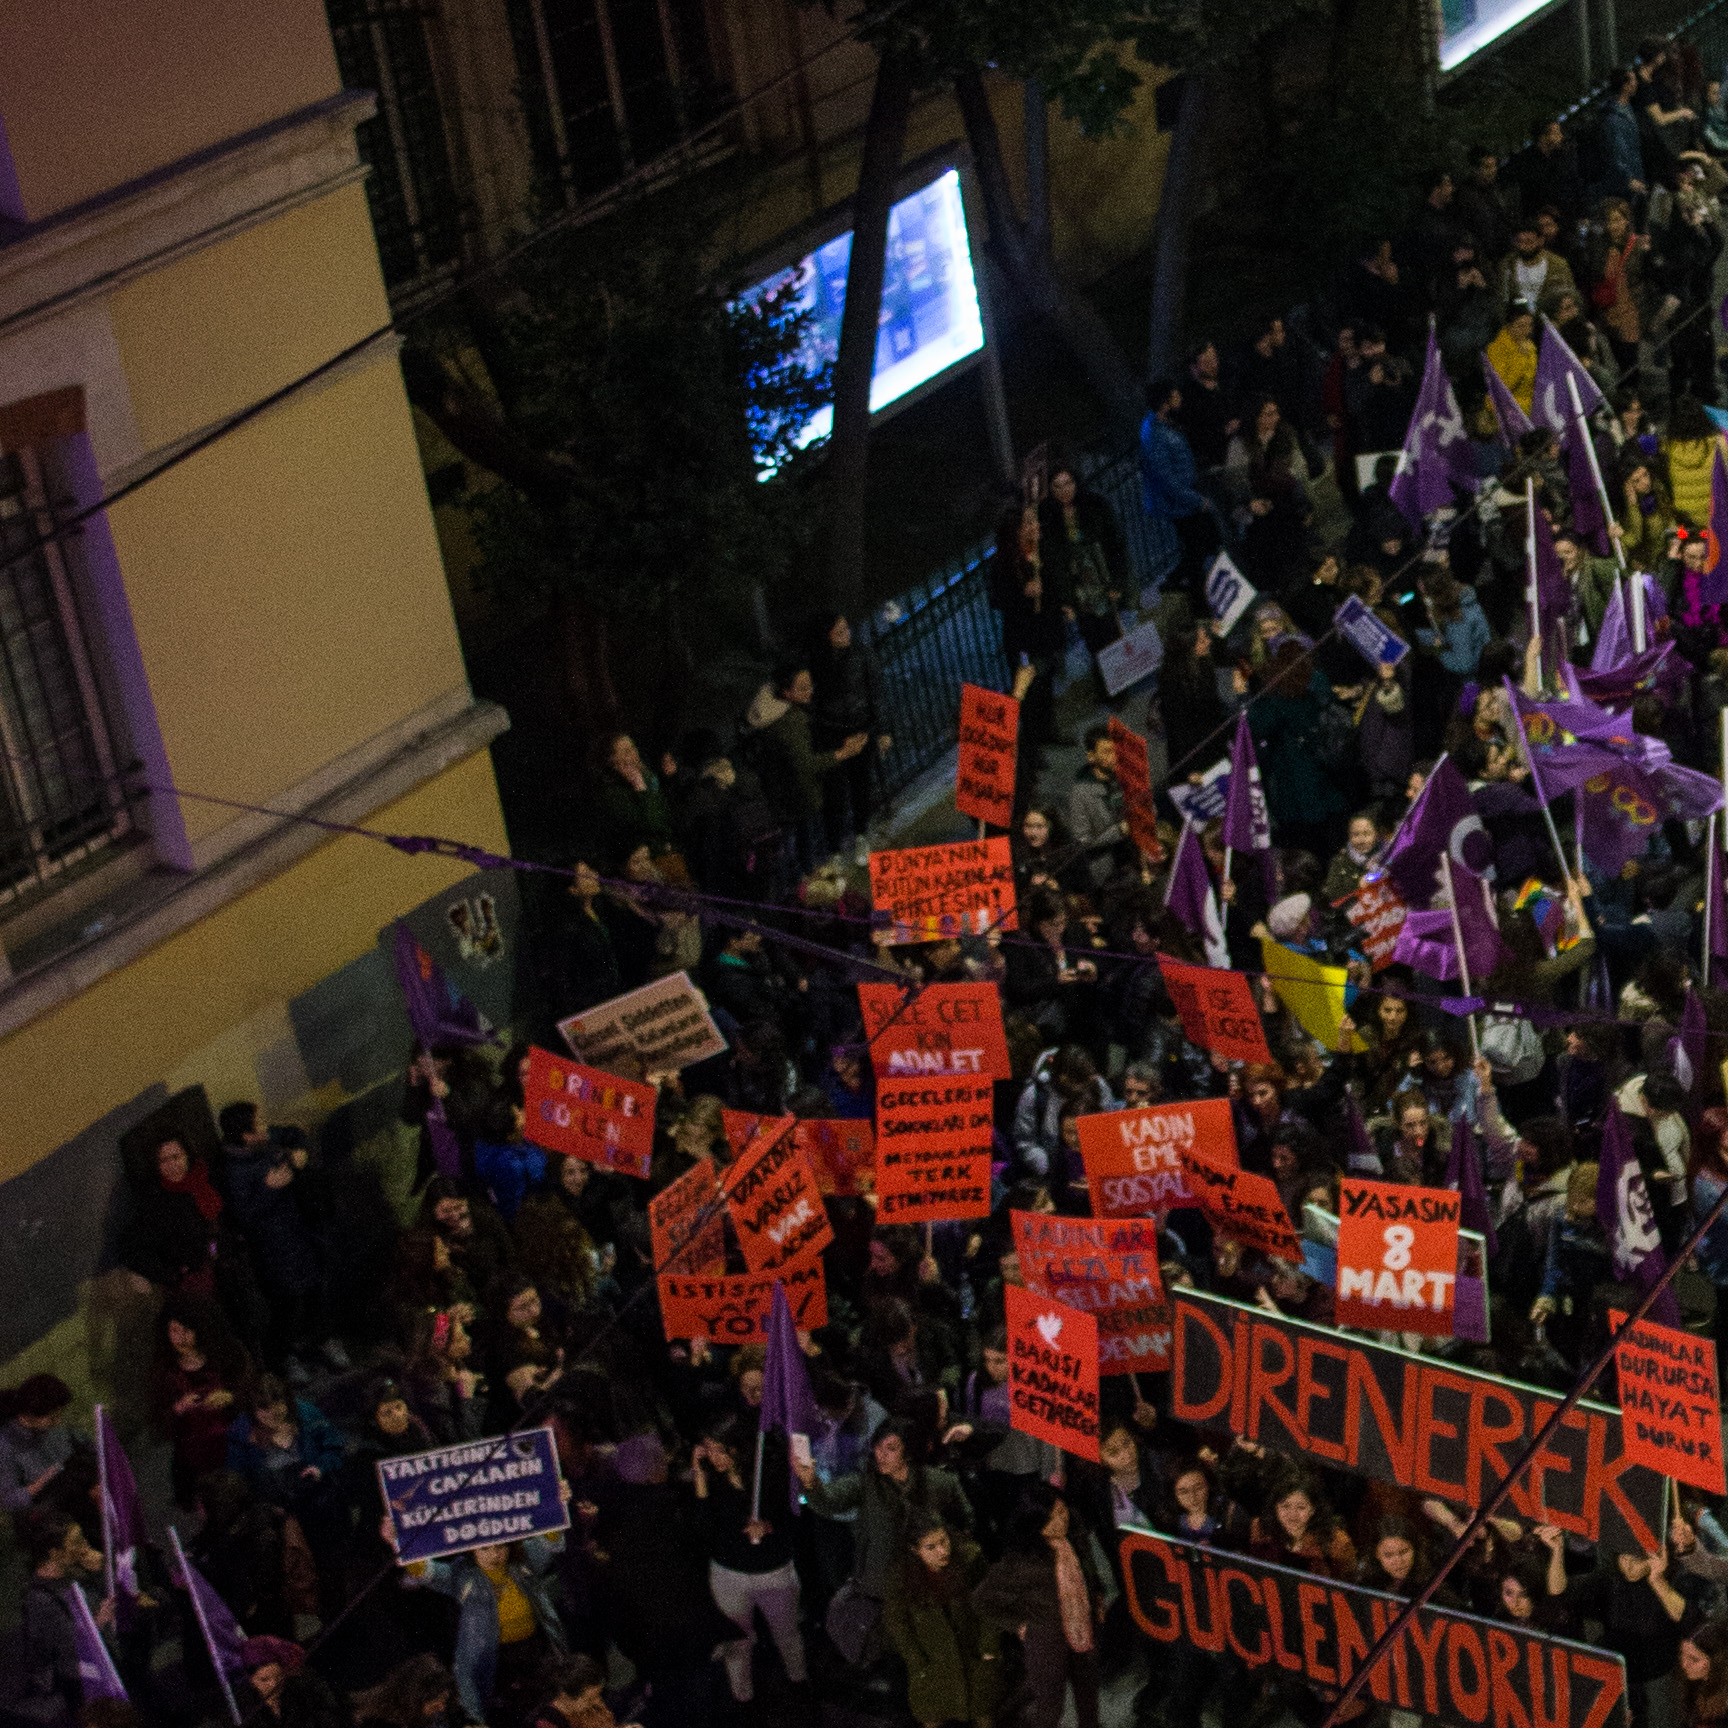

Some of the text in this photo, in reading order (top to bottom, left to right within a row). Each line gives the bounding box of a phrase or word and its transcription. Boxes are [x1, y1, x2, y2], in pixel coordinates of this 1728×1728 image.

[888, 1047, 986, 1074] ADALET
[1119, 1112, 1196, 1148] KADIN
[1382, 1223, 1416, 1272] 8
[1339, 1265, 1457, 1315] MART
[1619, 1351, 1715, 1399] DURURSA
[1622, 1383, 1713, 1429] HAYAT
